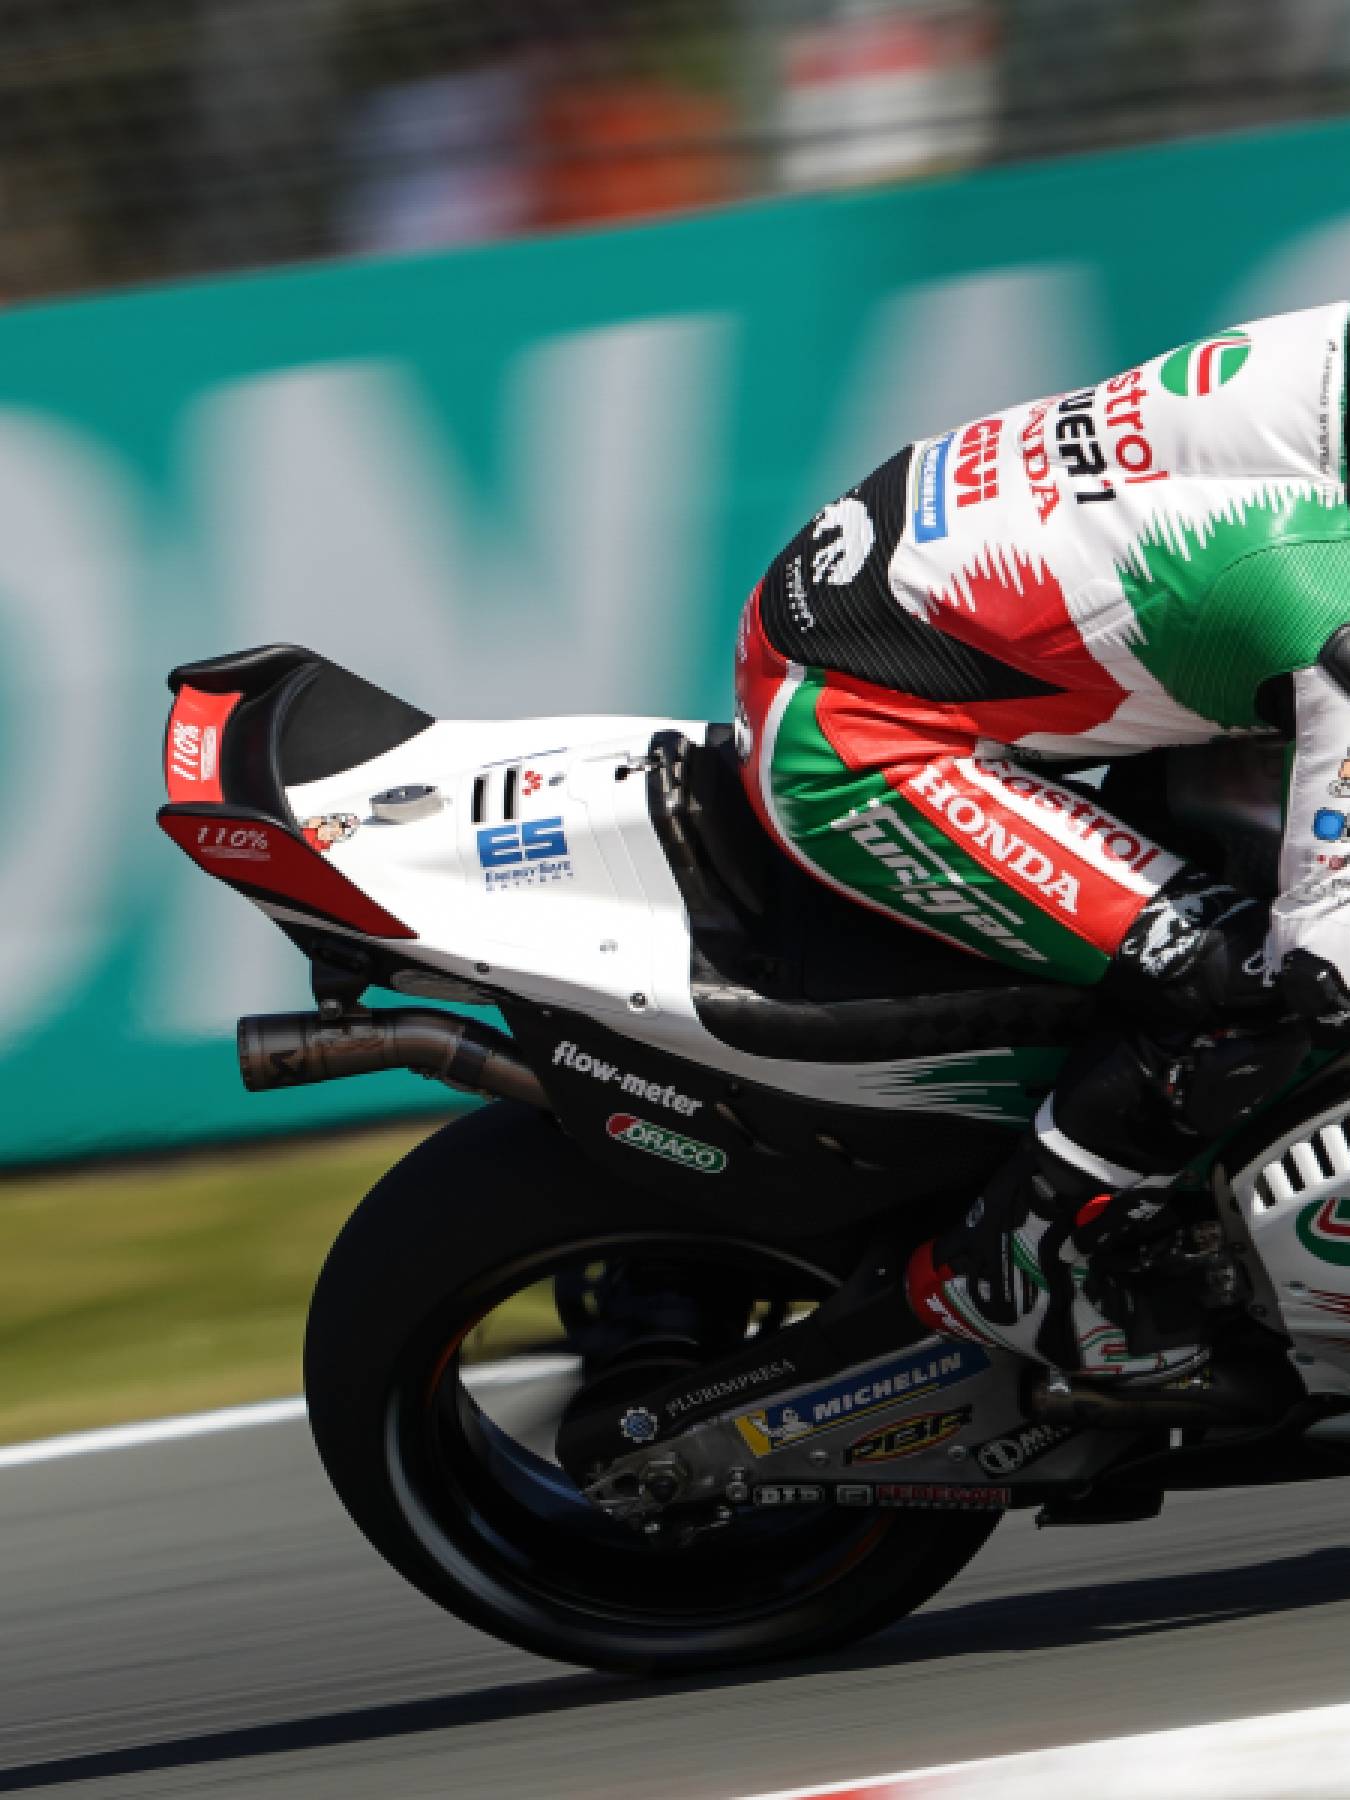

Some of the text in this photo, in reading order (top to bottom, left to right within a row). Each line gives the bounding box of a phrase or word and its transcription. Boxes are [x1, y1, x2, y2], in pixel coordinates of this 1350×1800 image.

[1018, 400, 1062, 524] NDA
[1057, 390, 1117, 505] WER1
[1109, 368, 1170, 484] strol
[171, 720, 202, 782] 110%
[196, 825, 269, 850] 110%
[476, 814, 569, 869] ES
[910, 761, 1080, 915] HONDA
[551, 1039, 705, 1117] flow-meter
[624, 1120, 718, 1169] DRACO
[812, 1351, 964, 1422] MICHELIN
